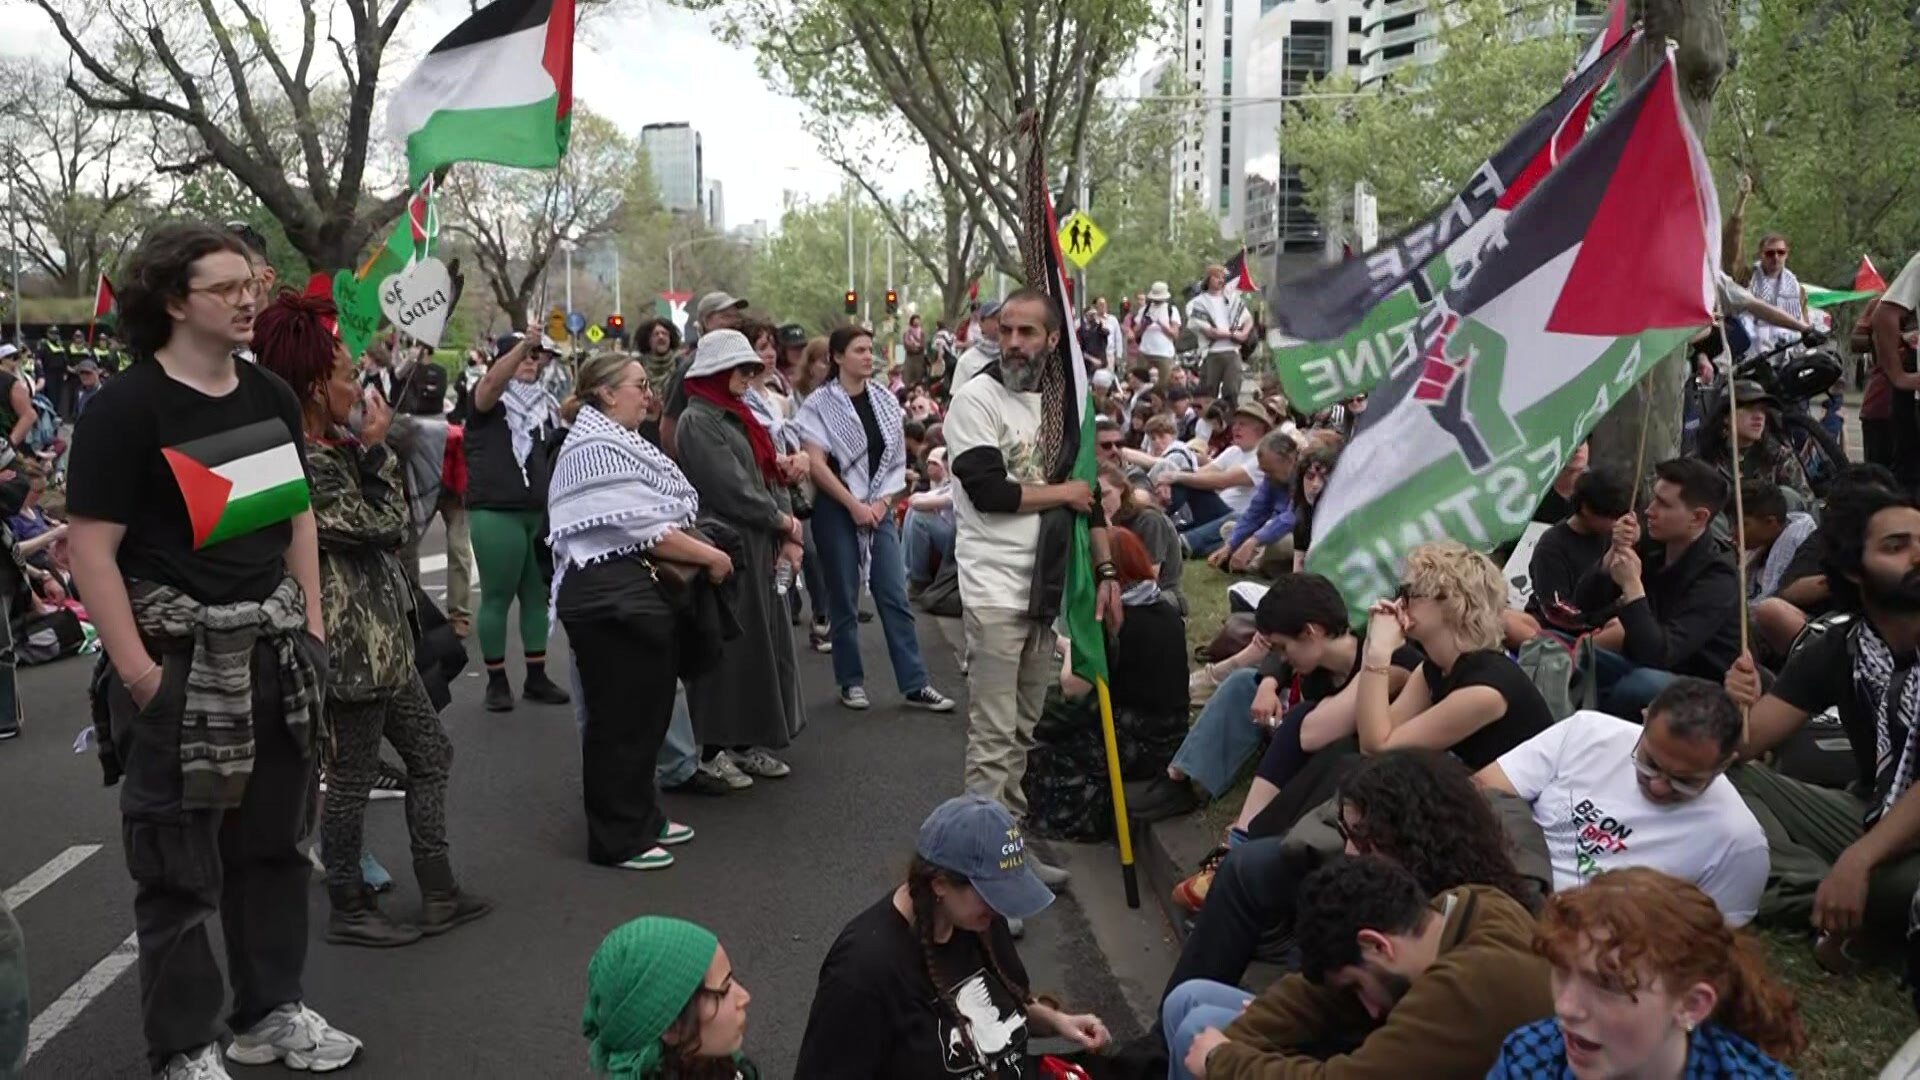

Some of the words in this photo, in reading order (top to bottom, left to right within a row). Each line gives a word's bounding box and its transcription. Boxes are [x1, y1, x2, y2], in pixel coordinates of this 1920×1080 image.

[399, 289, 446, 326] Gaza
[1006, 829, 1019, 841] TH
[1575, 799, 1604, 823] BE
[1599, 816, 1633, 840] ON
